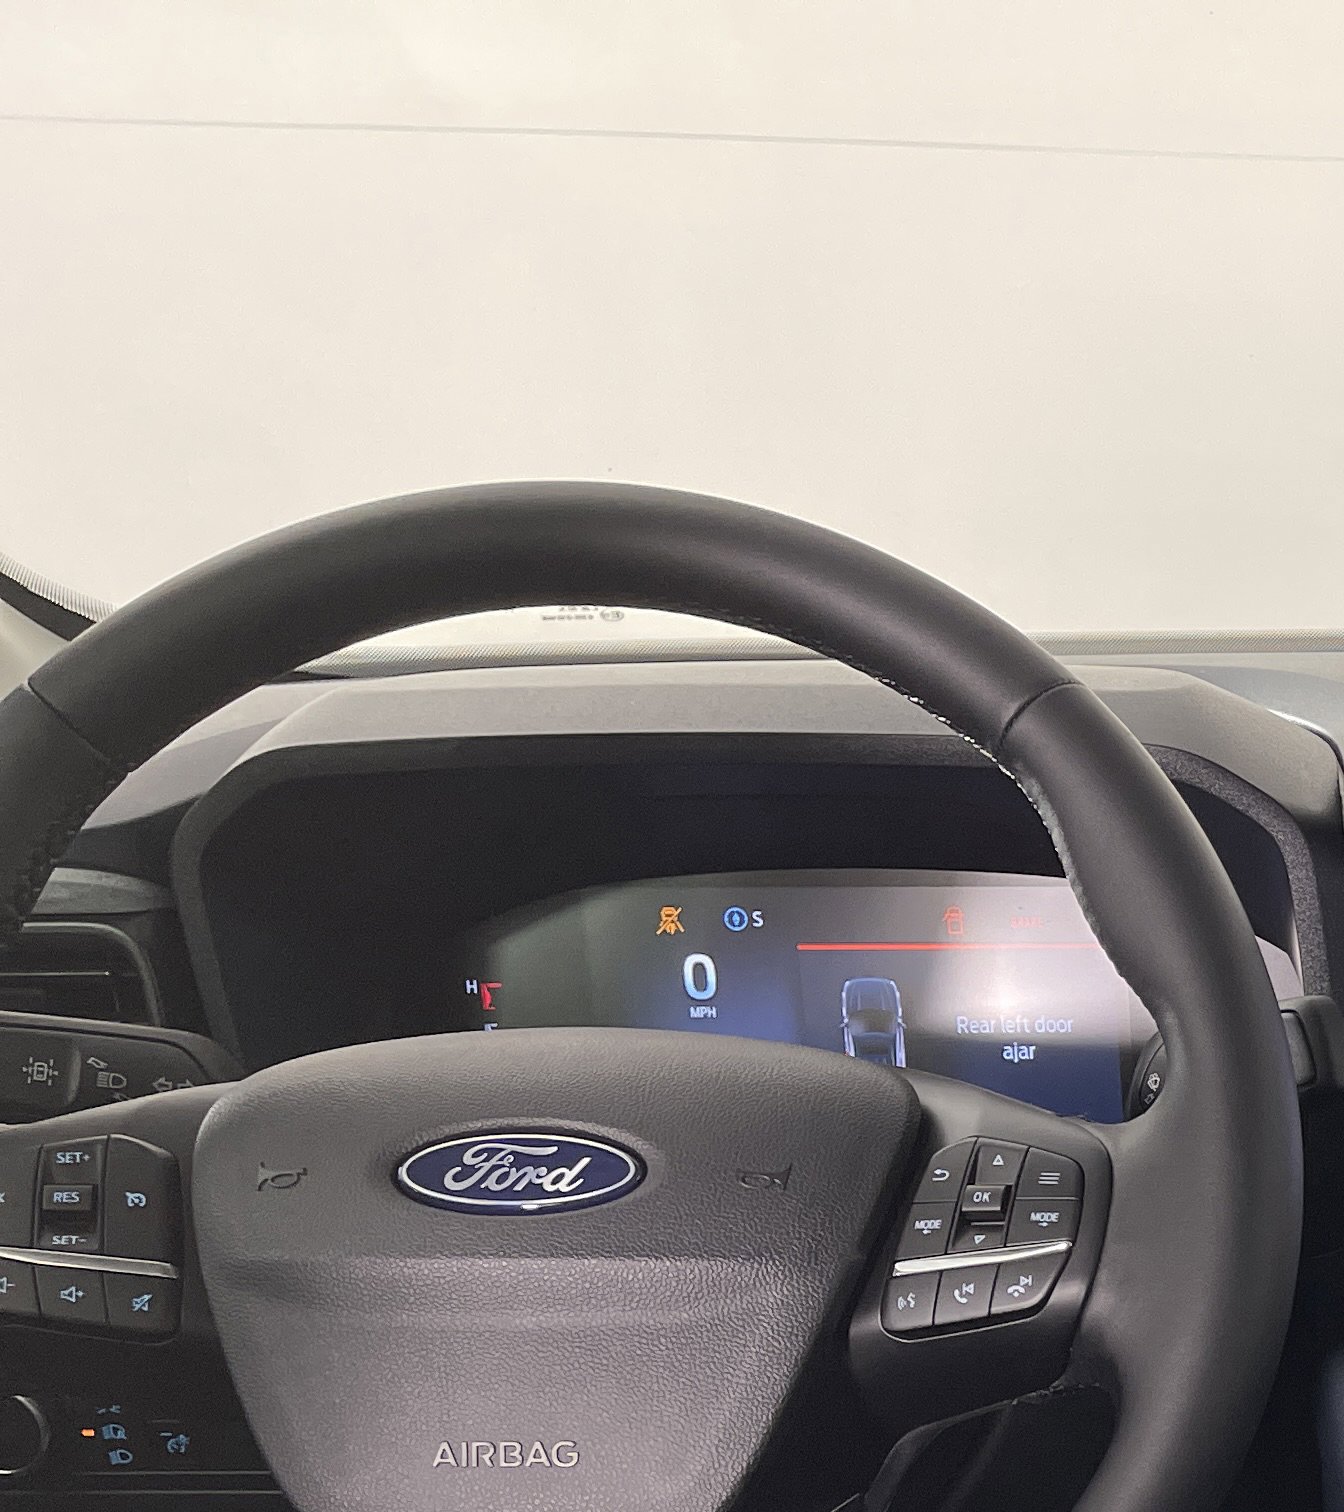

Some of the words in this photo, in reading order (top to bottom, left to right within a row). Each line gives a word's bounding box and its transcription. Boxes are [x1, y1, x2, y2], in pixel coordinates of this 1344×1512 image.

[751, 910, 765, 928] S
[682, 953, 717, 1001] 0
[465, 979, 478, 994] H
[690, 1006, 717, 1020] MPH
[956, 1014, 996, 1036] Rear
[1001, 1013, 1029, 1036] left
[1034, 1013, 1074, 1035] door
[1002, 1042, 1037, 1064] ajar
[444, 1143, 592, 1193] Ford
[53, 1192, 80, 1203] RES
[973, 1192, 991, 1203] OK
[914, 1219, 942, 1230] MODE
[1030, 1212, 1059, 1223] MODE
[433, 1440, 579, 1468] AIRBAG
